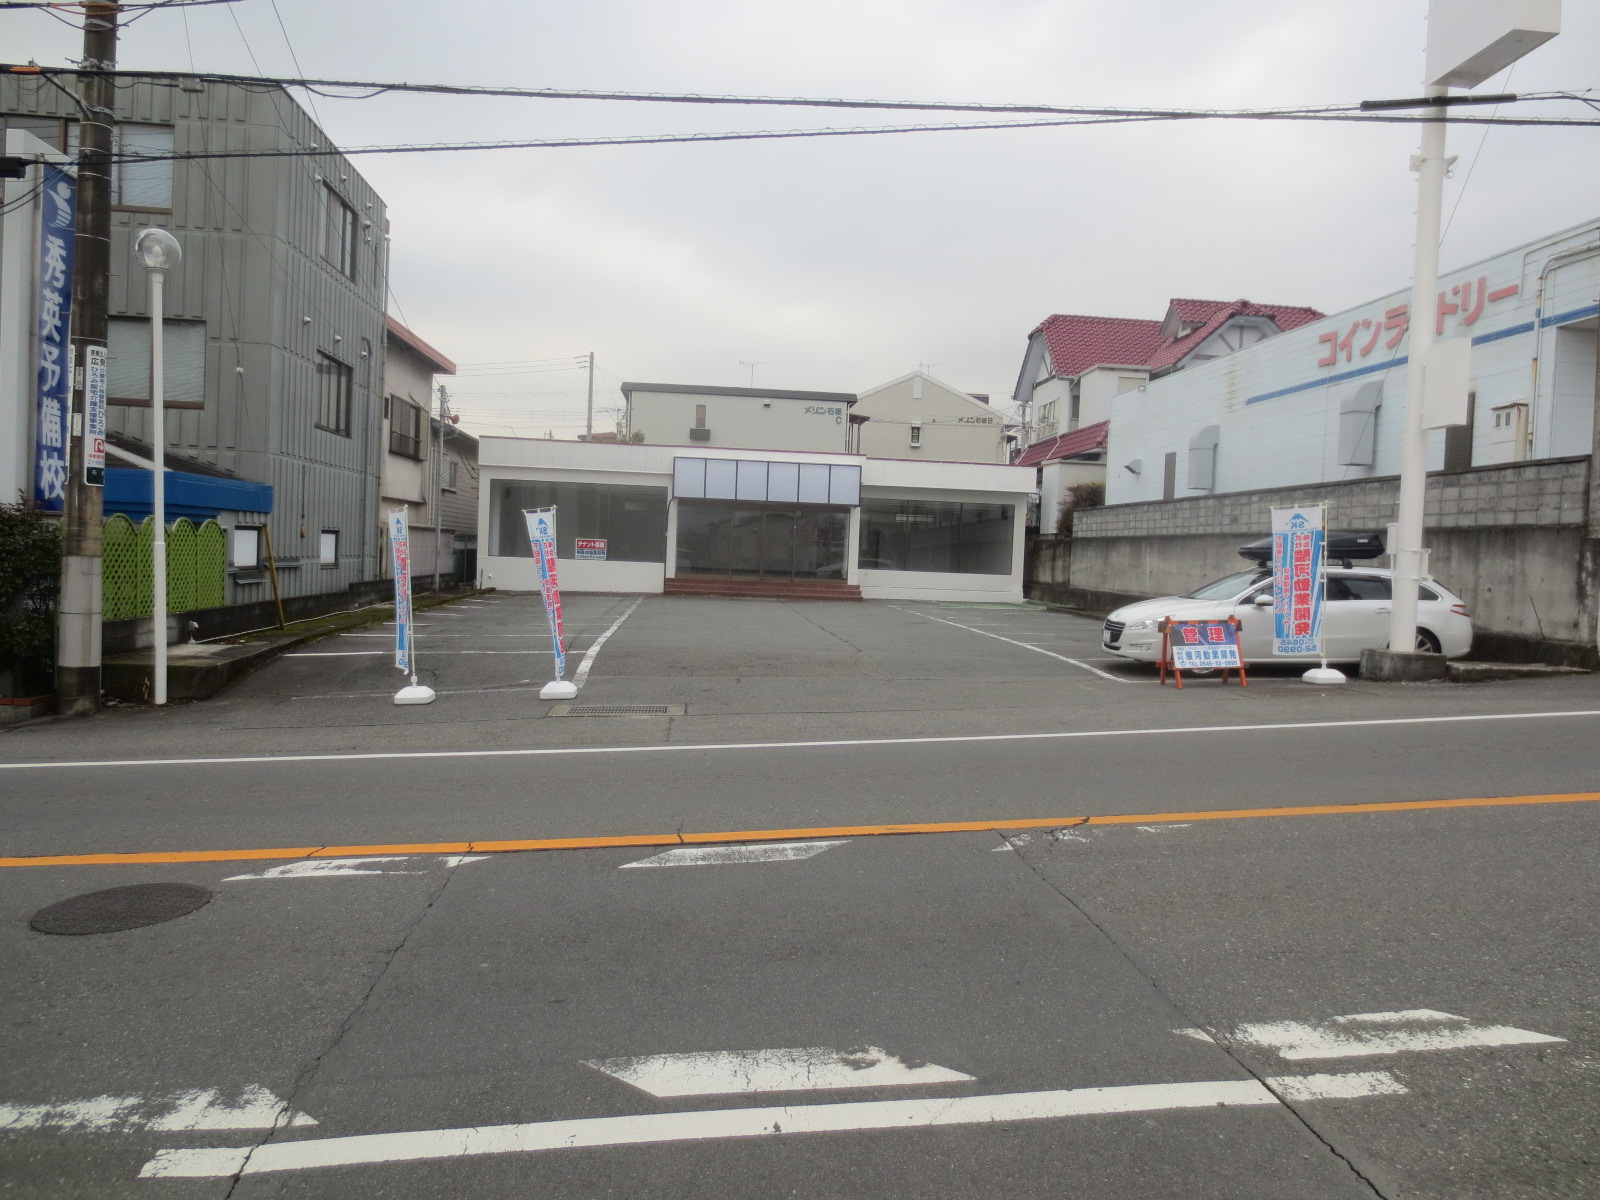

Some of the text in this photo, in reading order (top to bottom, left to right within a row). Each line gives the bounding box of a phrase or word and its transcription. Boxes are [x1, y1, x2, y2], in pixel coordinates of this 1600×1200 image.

[1318, 277, 1519, 367] コインラドリー
[40, 234, 67, 501] 秀英予備校
[1182, 626, 1225, 643] 管理
